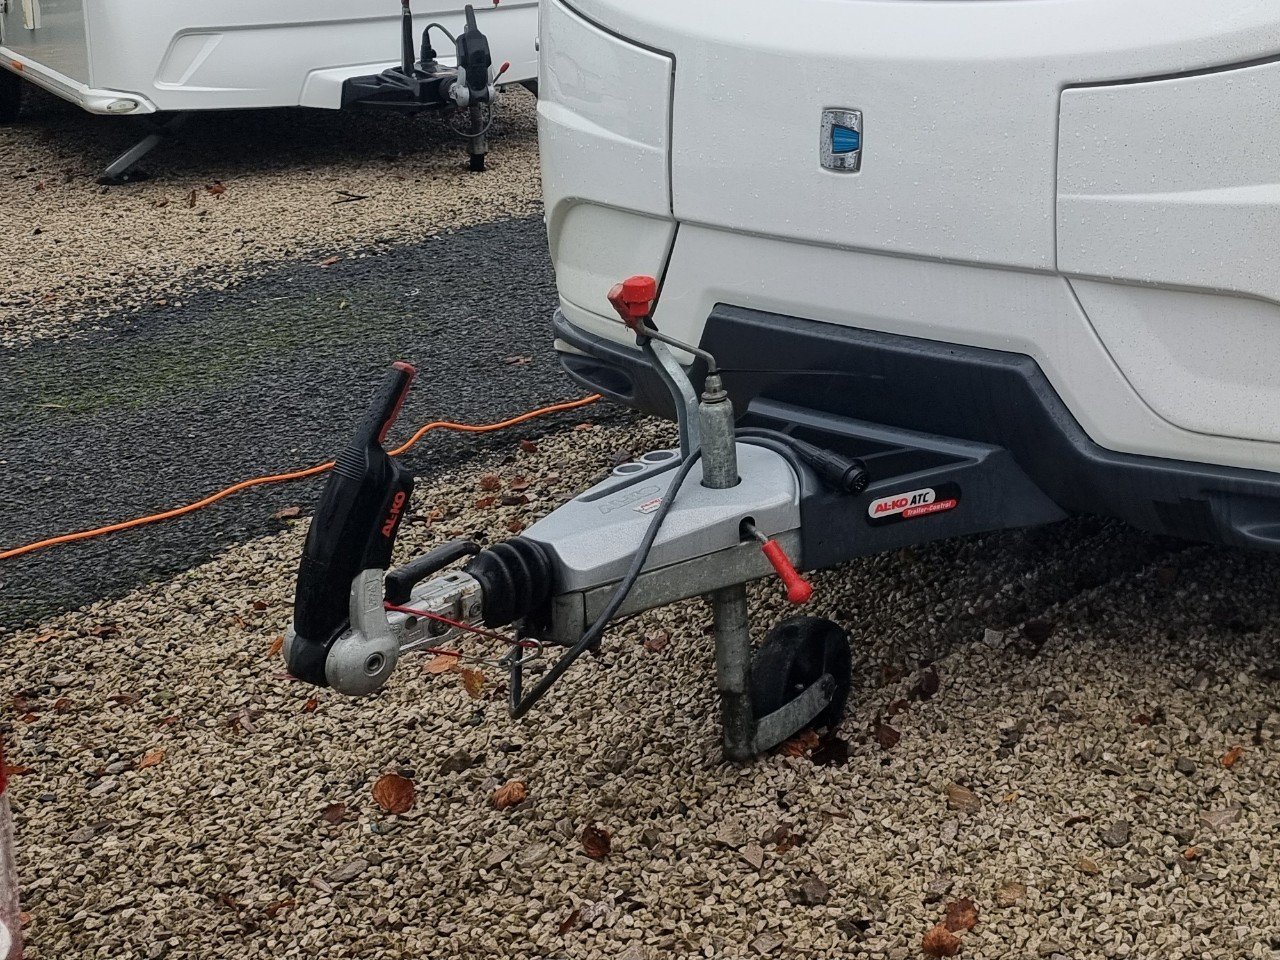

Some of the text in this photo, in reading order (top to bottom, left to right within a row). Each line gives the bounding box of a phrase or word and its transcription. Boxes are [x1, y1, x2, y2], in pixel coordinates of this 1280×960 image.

[382, 491, 406, 537] AL-KO
[874, 492, 930, 514] AL-KO ATC
